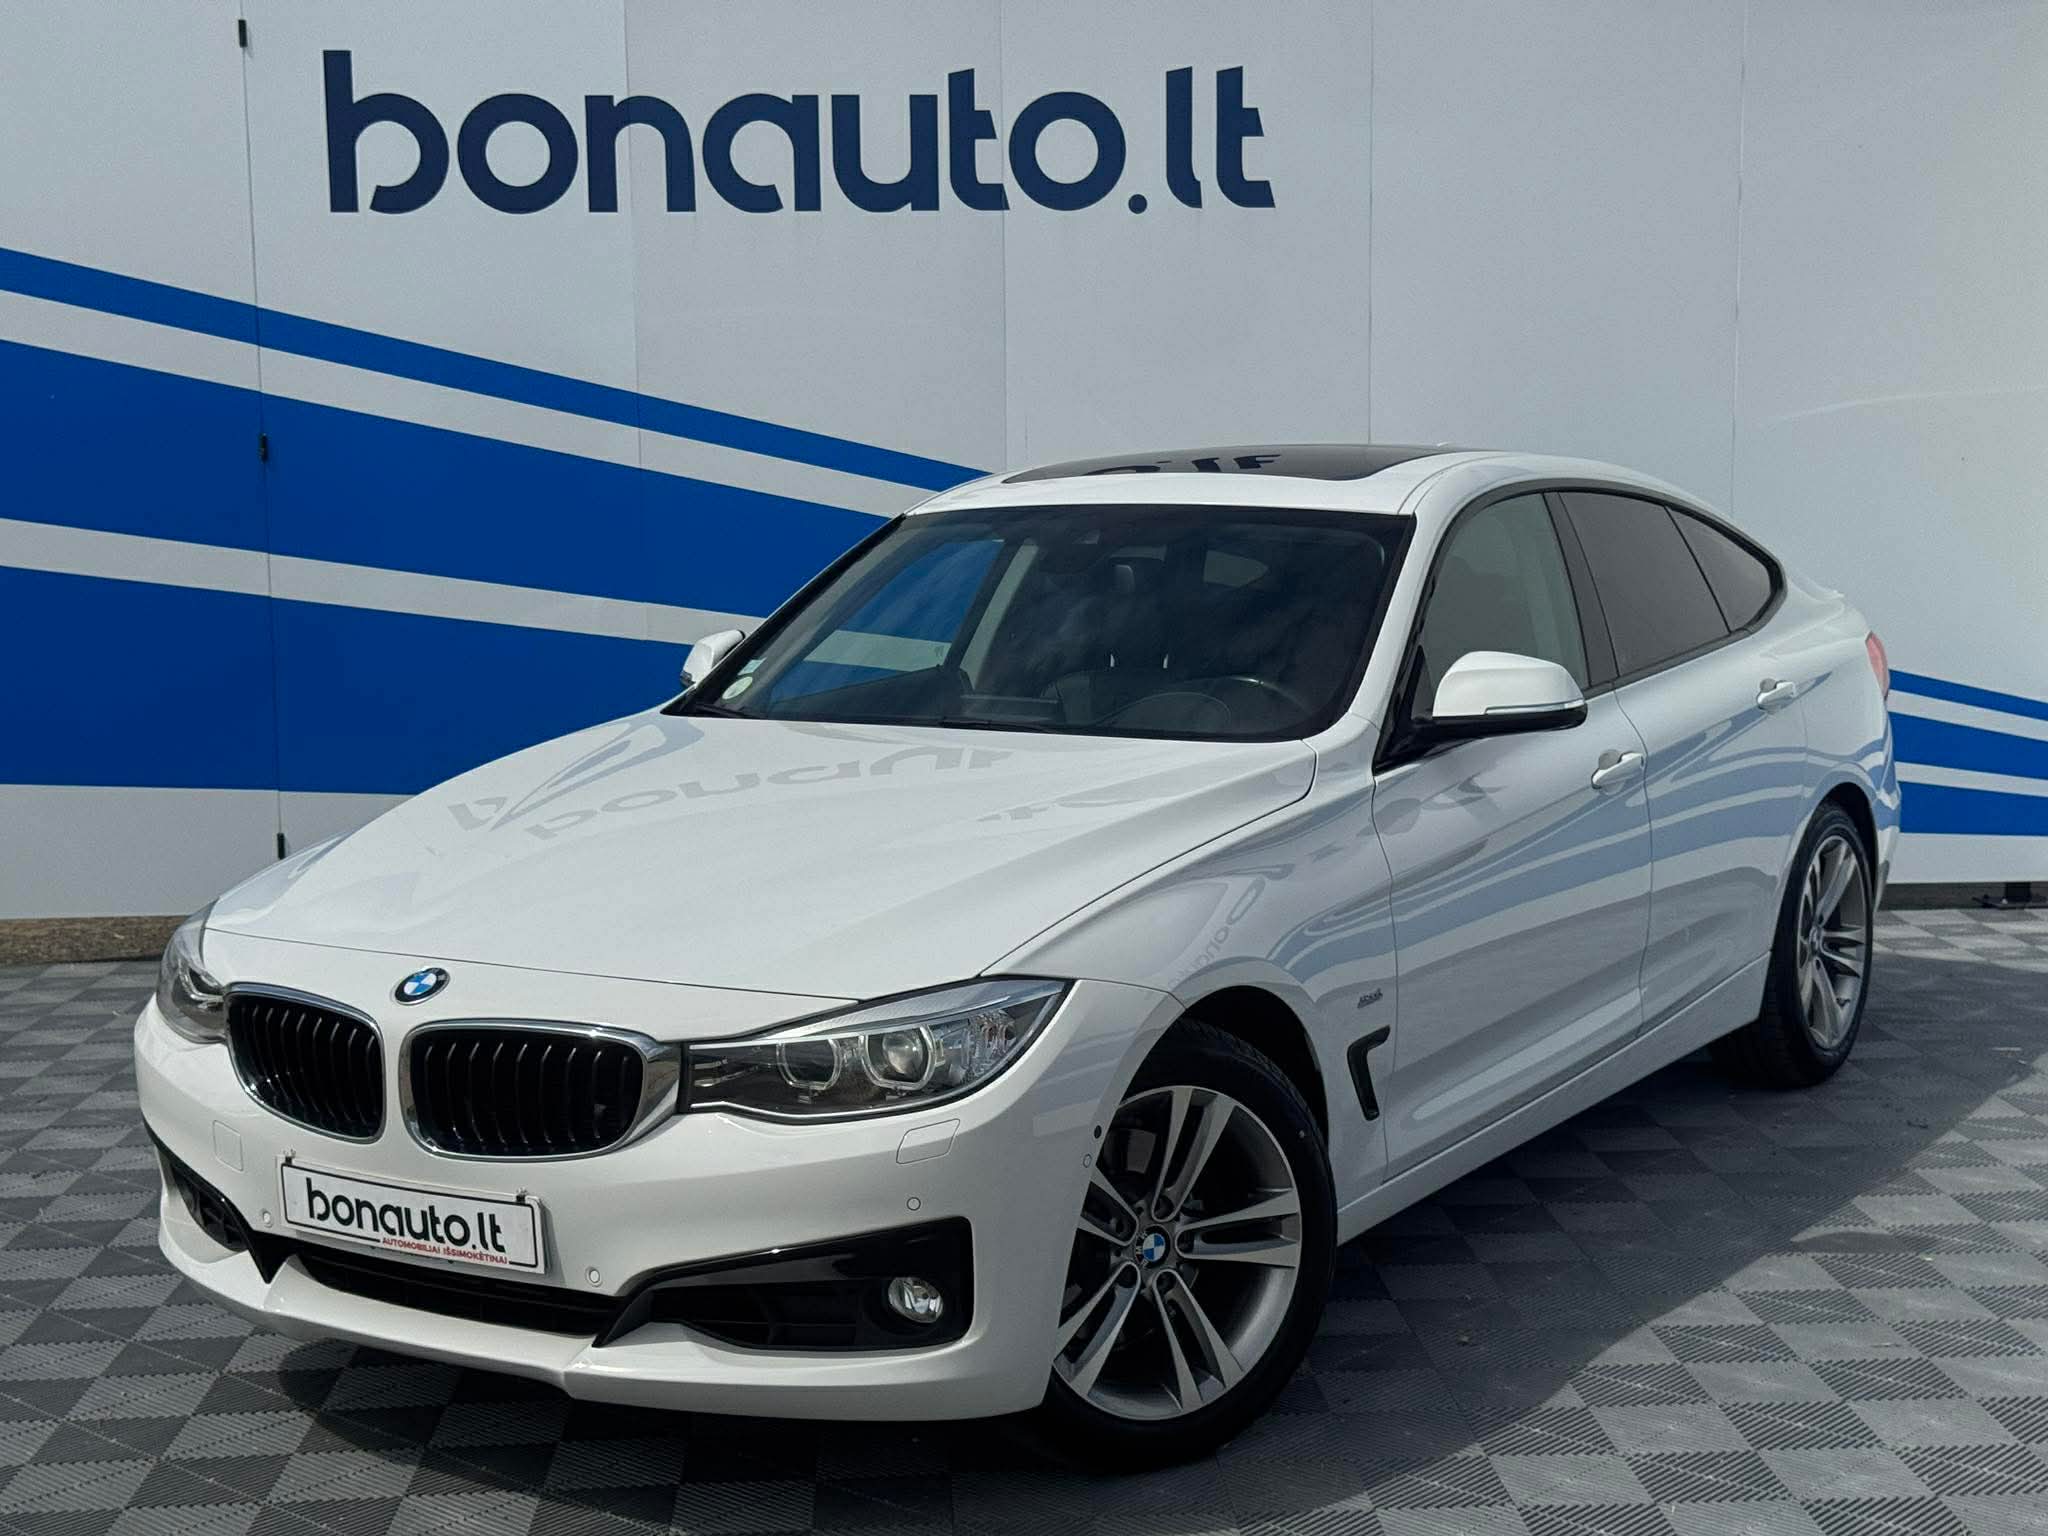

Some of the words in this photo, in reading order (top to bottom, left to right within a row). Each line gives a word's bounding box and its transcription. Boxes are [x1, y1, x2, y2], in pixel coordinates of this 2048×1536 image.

[323, 50, 1274, 212] bonauto.lt
[306, 1177, 506, 1253] bonauto.lt
[382, 1237, 441, 1254] AUTOMOBILIAI
